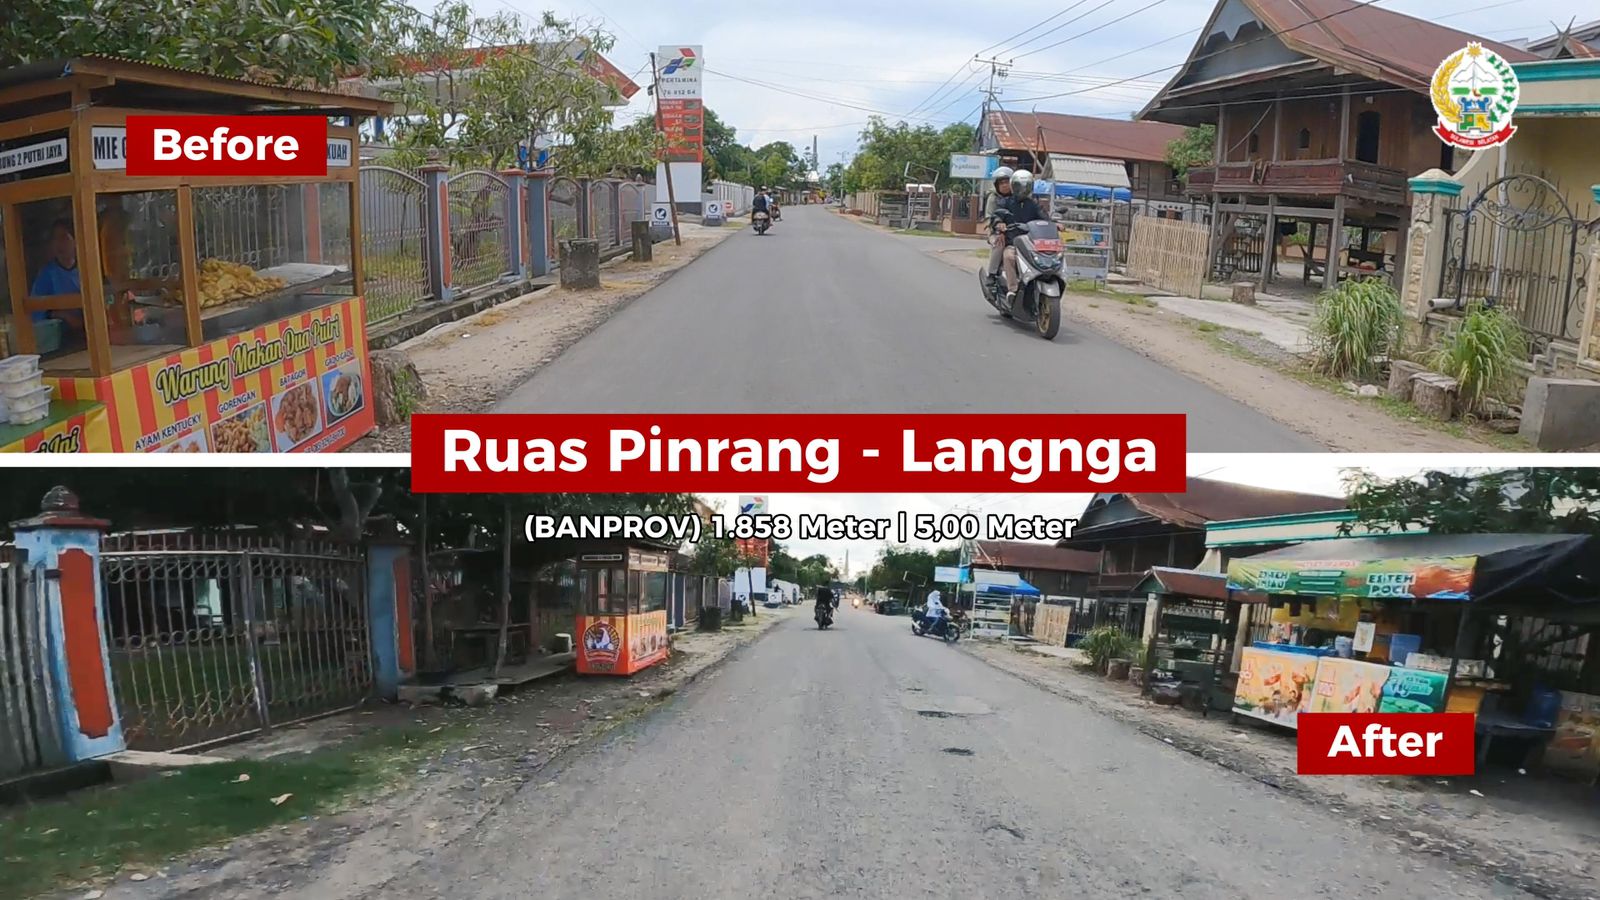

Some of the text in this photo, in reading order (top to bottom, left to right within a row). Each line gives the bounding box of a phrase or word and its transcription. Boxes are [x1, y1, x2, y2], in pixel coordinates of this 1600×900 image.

[17, 153, 22, 166] 2
[23, 147, 45, 165] PUTRI
[93, 136, 118, 160] MIE
[156, 315, 341, 405] Warung Makan Dua Putri
[218, 391, 256, 414] GORENGAN
[135, 414, 202, 450] AYAM KENTUCKY
